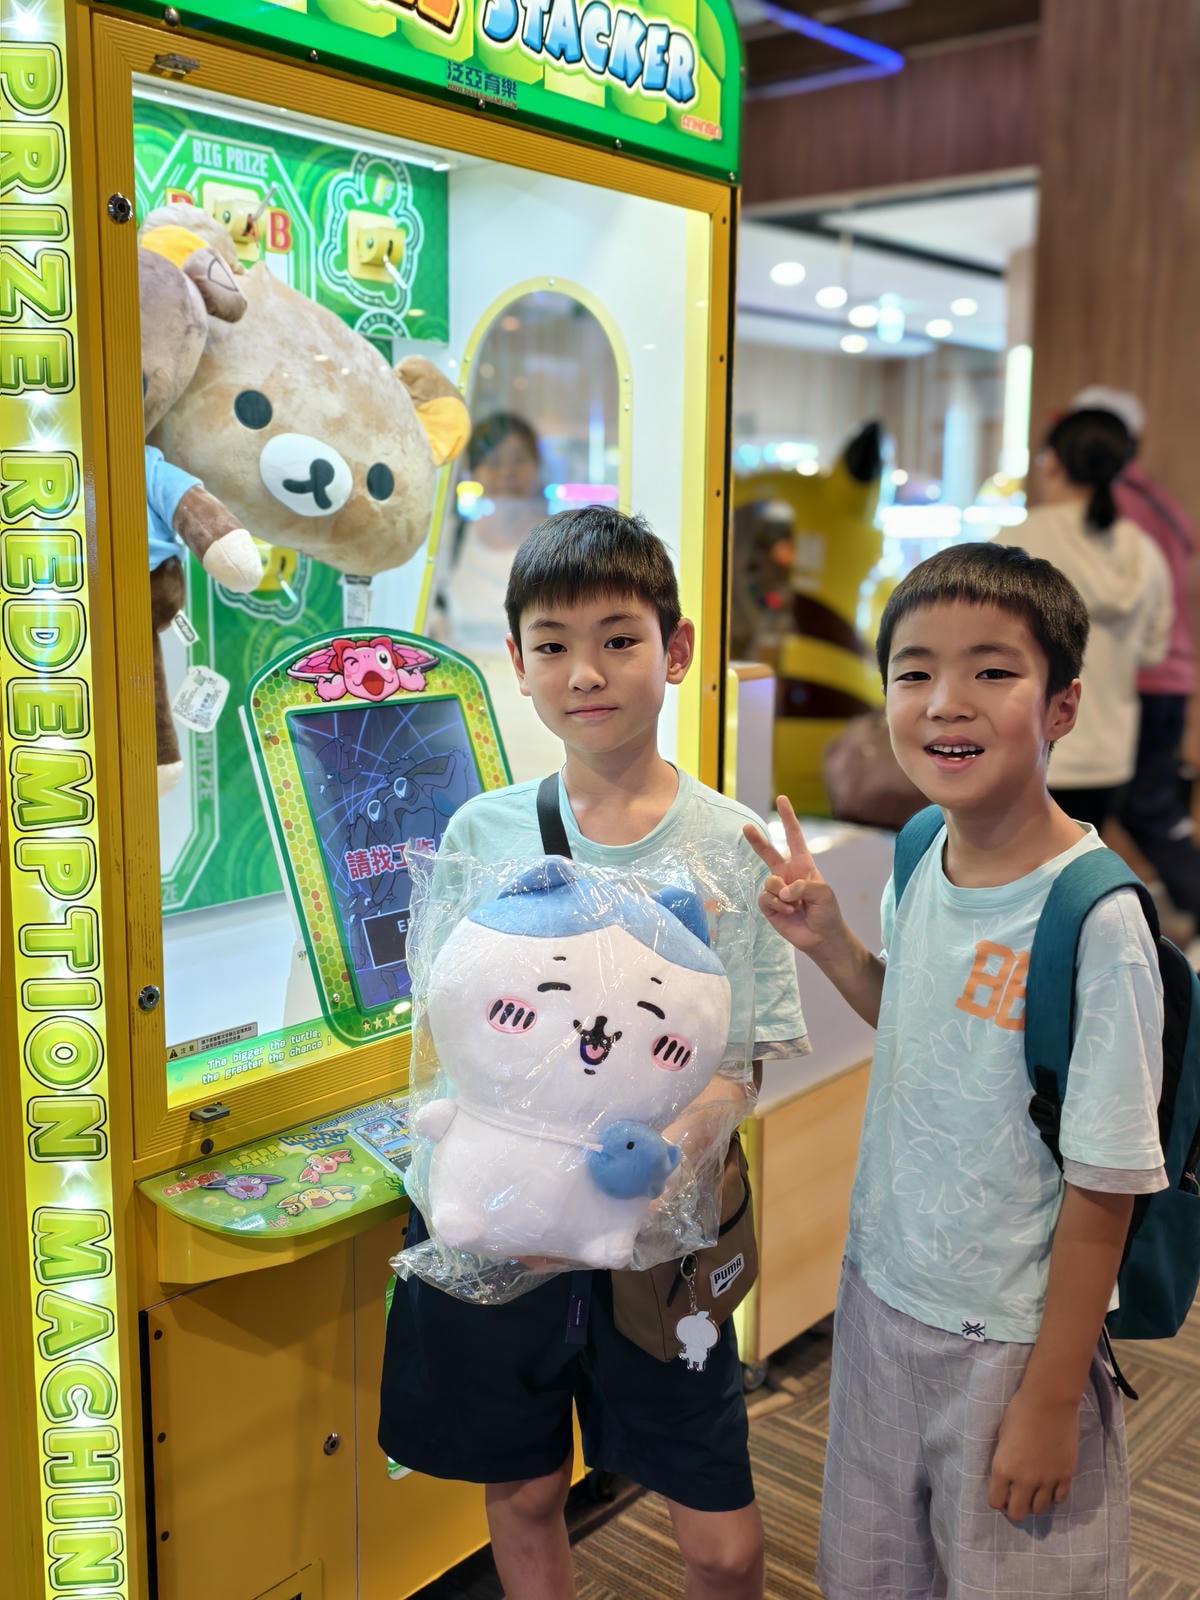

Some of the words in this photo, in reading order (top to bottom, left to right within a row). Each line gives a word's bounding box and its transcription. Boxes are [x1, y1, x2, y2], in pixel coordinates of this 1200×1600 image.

[483, 0, 696, 103] STACKER
[447, 60, 517, 101] 泛亞育樂
[192, 139, 223, 169] BIG
[226, 146, 269, 179] PRIZE
[0, 41, 76, 395] PRIZE
[268, 208, 292, 253] B
[1, 450, 108, 1163] REDEMPTION
[202, 1072, 220, 1085] the
[225, 1058, 263, 1080] greater
[268, 1052, 285, 1064] the
[289, 1040, 323, 1058] chance
[208, 1057, 227, 1071] The
[233, 1046, 264, 1063] bigger
[270, 1039, 286, 1051] the
[280, 1132, 321, 1145] HOW
[303, 1136, 345, 1150] PLAY
[713, 1257, 742, 1285] PUMA
[32, 1206, 126, 1600] MACHIN
